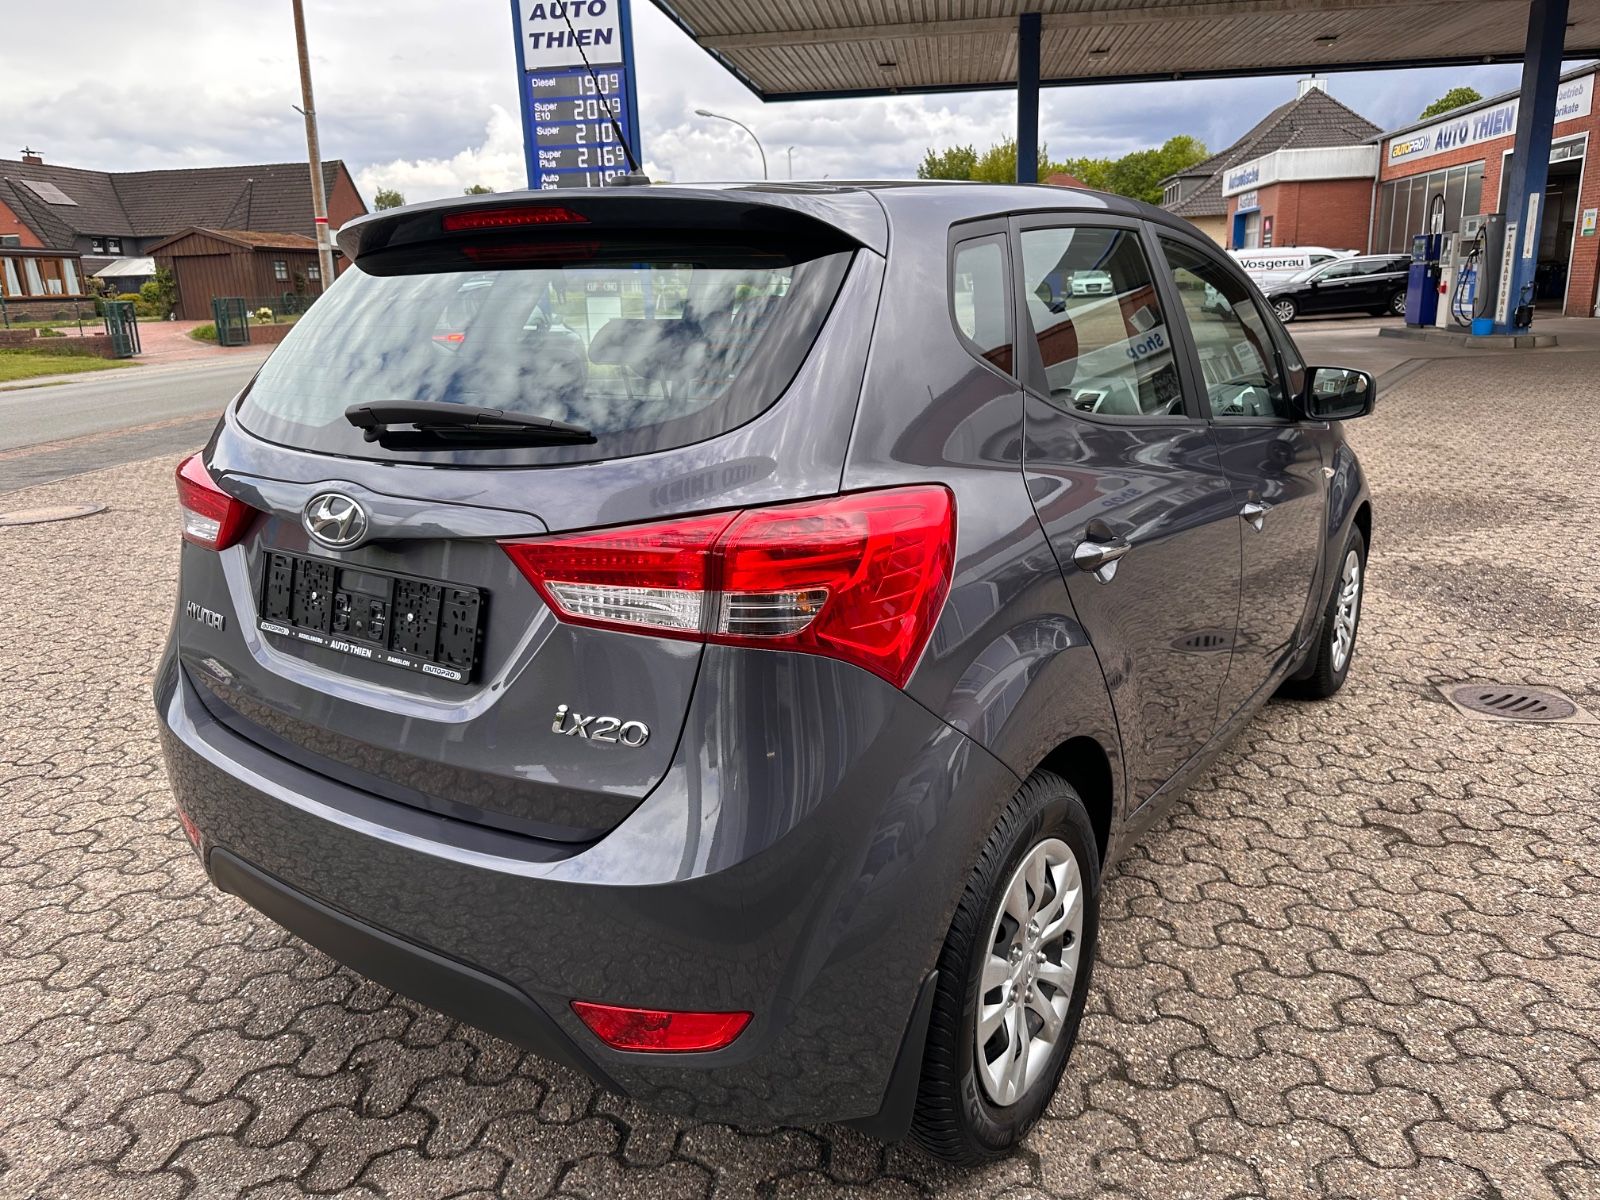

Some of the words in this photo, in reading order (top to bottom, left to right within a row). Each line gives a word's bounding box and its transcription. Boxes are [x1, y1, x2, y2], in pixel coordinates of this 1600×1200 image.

[529, 0, 607, 21] AUTO
[529, 27, 613, 49] THIEN
[532, 78, 556, 87] Diesel
[578, 73, 619, 95] 1909
[534, 102, 558, 113] Super
[574, 98, 621, 120] 2049
[535, 112, 551, 121] E10
[536, 126, 560, 137] Super
[1435, 120, 1469, 151] AUTO
[1472, 105, 1515, 140] THIEN
[539, 149, 562, 160] Super
[578, 146, 625, 168] 2169
[540, 159, 557, 168] Plus
[541, 173, 560, 182] Auto
[1241, 259, 1304, 270] Vosgerau
[186, 600, 226, 632] HYUNDAI
[330, 640, 349, 652] AUTO
[350, 644, 372, 658] THIEN
[424, 665, 455, 678] AUTOPRO
[552, 704, 649, 748] ix20
